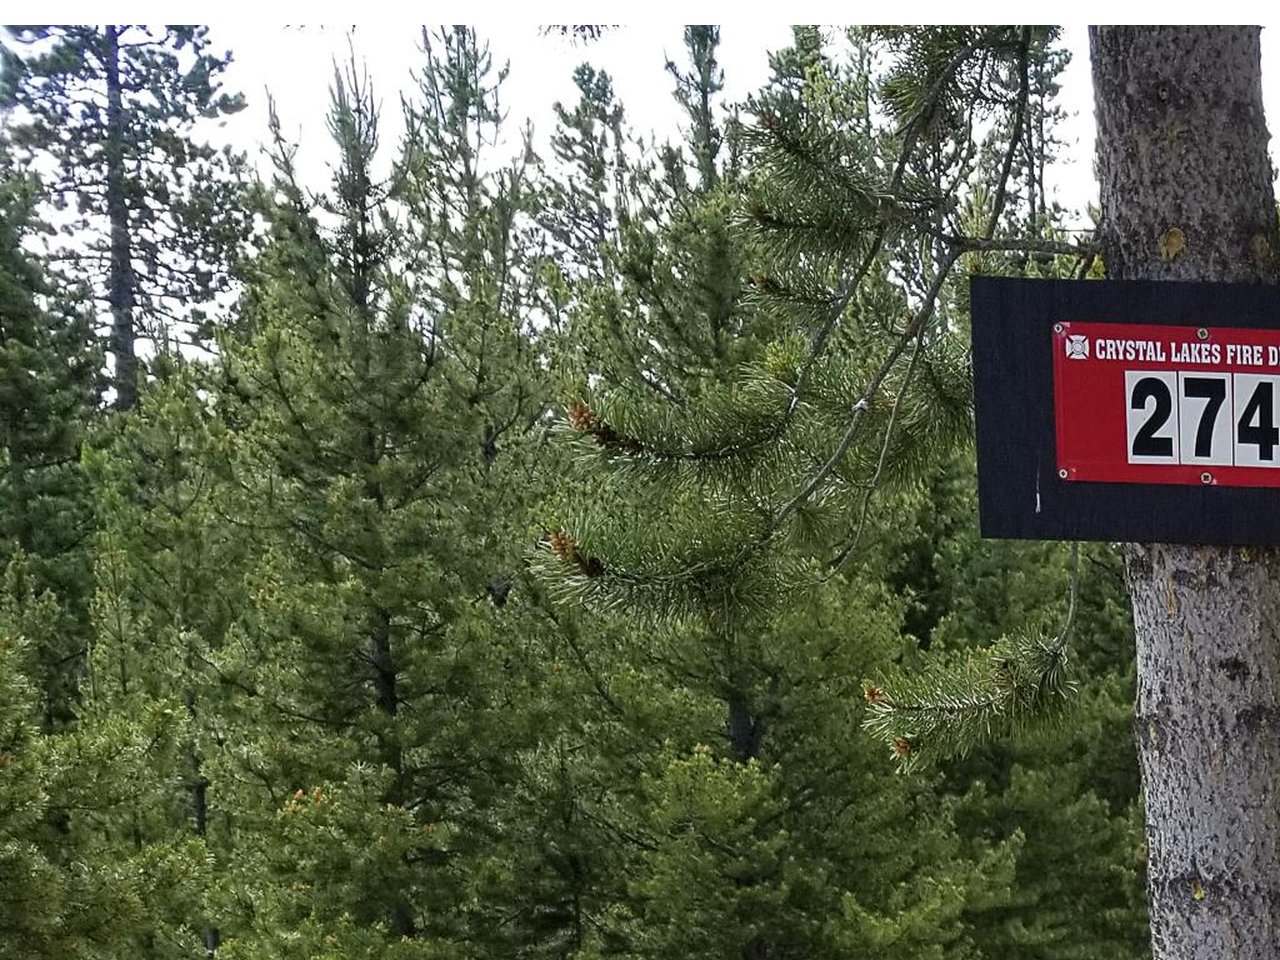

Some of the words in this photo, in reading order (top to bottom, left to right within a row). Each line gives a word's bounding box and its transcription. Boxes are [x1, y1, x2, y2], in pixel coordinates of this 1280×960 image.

[1096, 338, 1167, 362] CRYSTAL
[1171, 341, 1221, 364] LAKES
[1227, 344, 1263, 366] FIRE
[1131, 376, 1280, 462] 274
